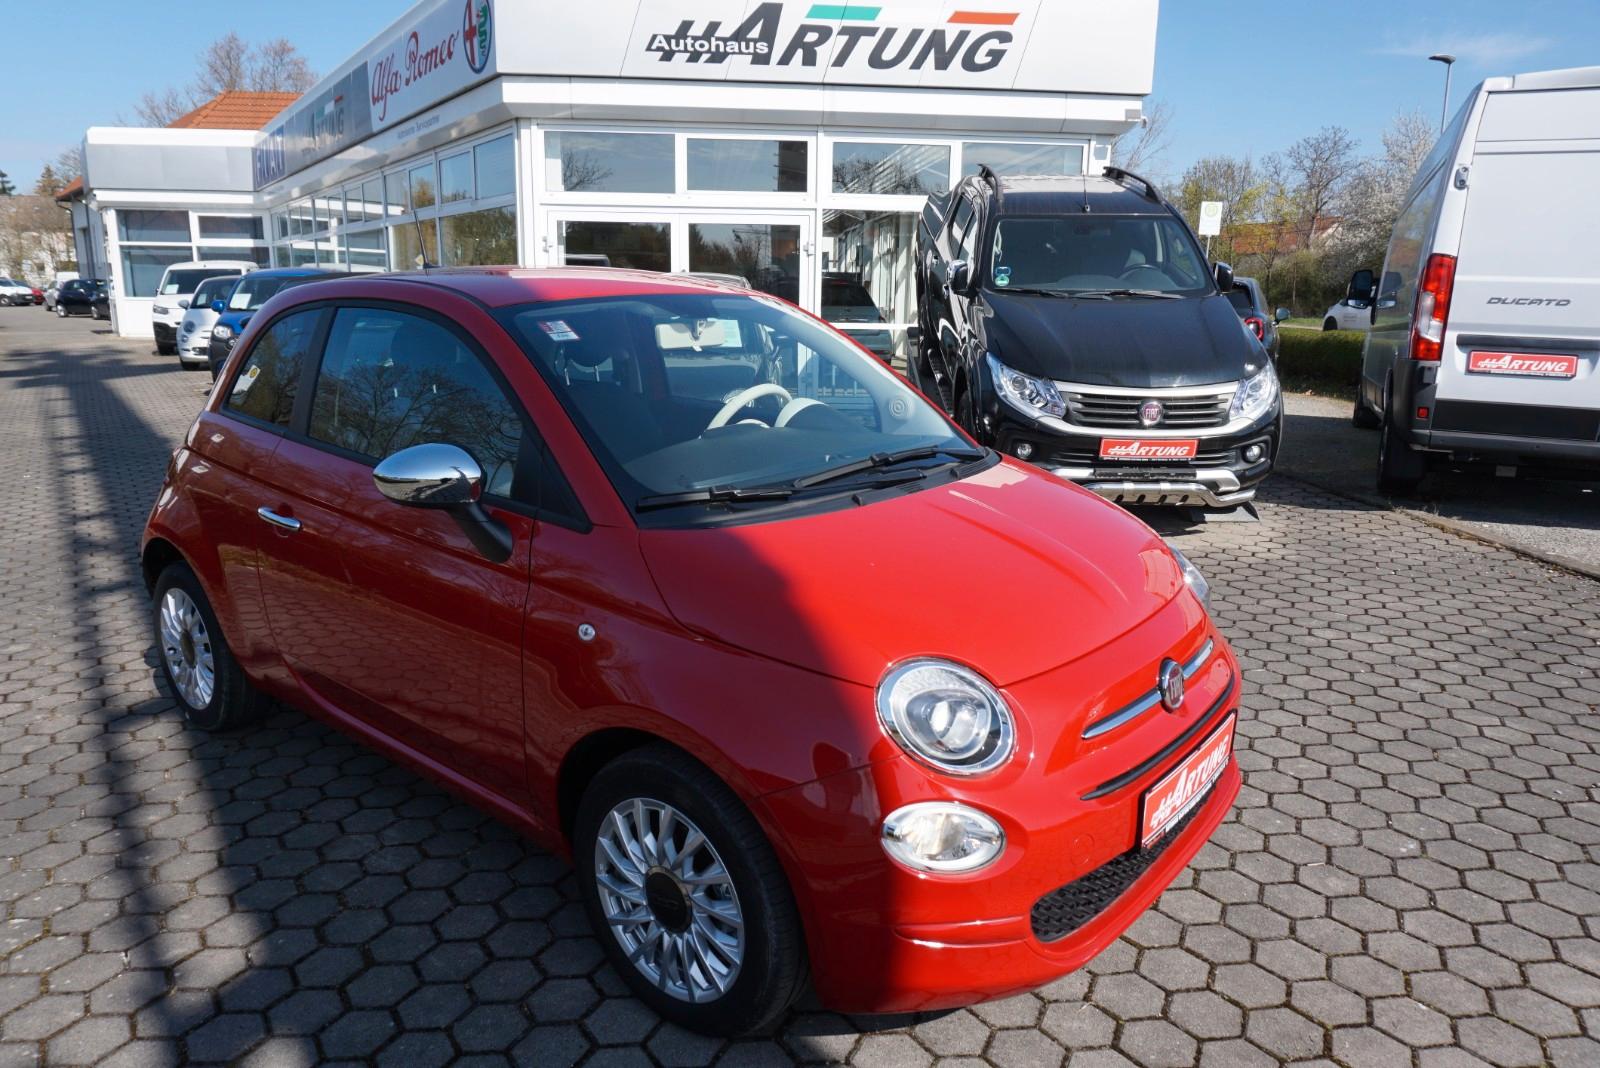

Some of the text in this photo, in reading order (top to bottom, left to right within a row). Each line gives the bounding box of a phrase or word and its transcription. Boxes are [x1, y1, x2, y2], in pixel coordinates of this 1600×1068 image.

[646, 2, 1014, 72] HARTUNG
[650, 34, 769, 54] Autohaus
[371, 31, 460, 122] Alfa Romeo
[1486, 297, 1571, 306] DUCATO
[1476, 355, 1569, 372] HARTUNG
[1145, 408, 1159, 421] FIAT
[1107, 441, 1190, 456] HARTUNG
[1149, 734, 1229, 829] HARTUNG
